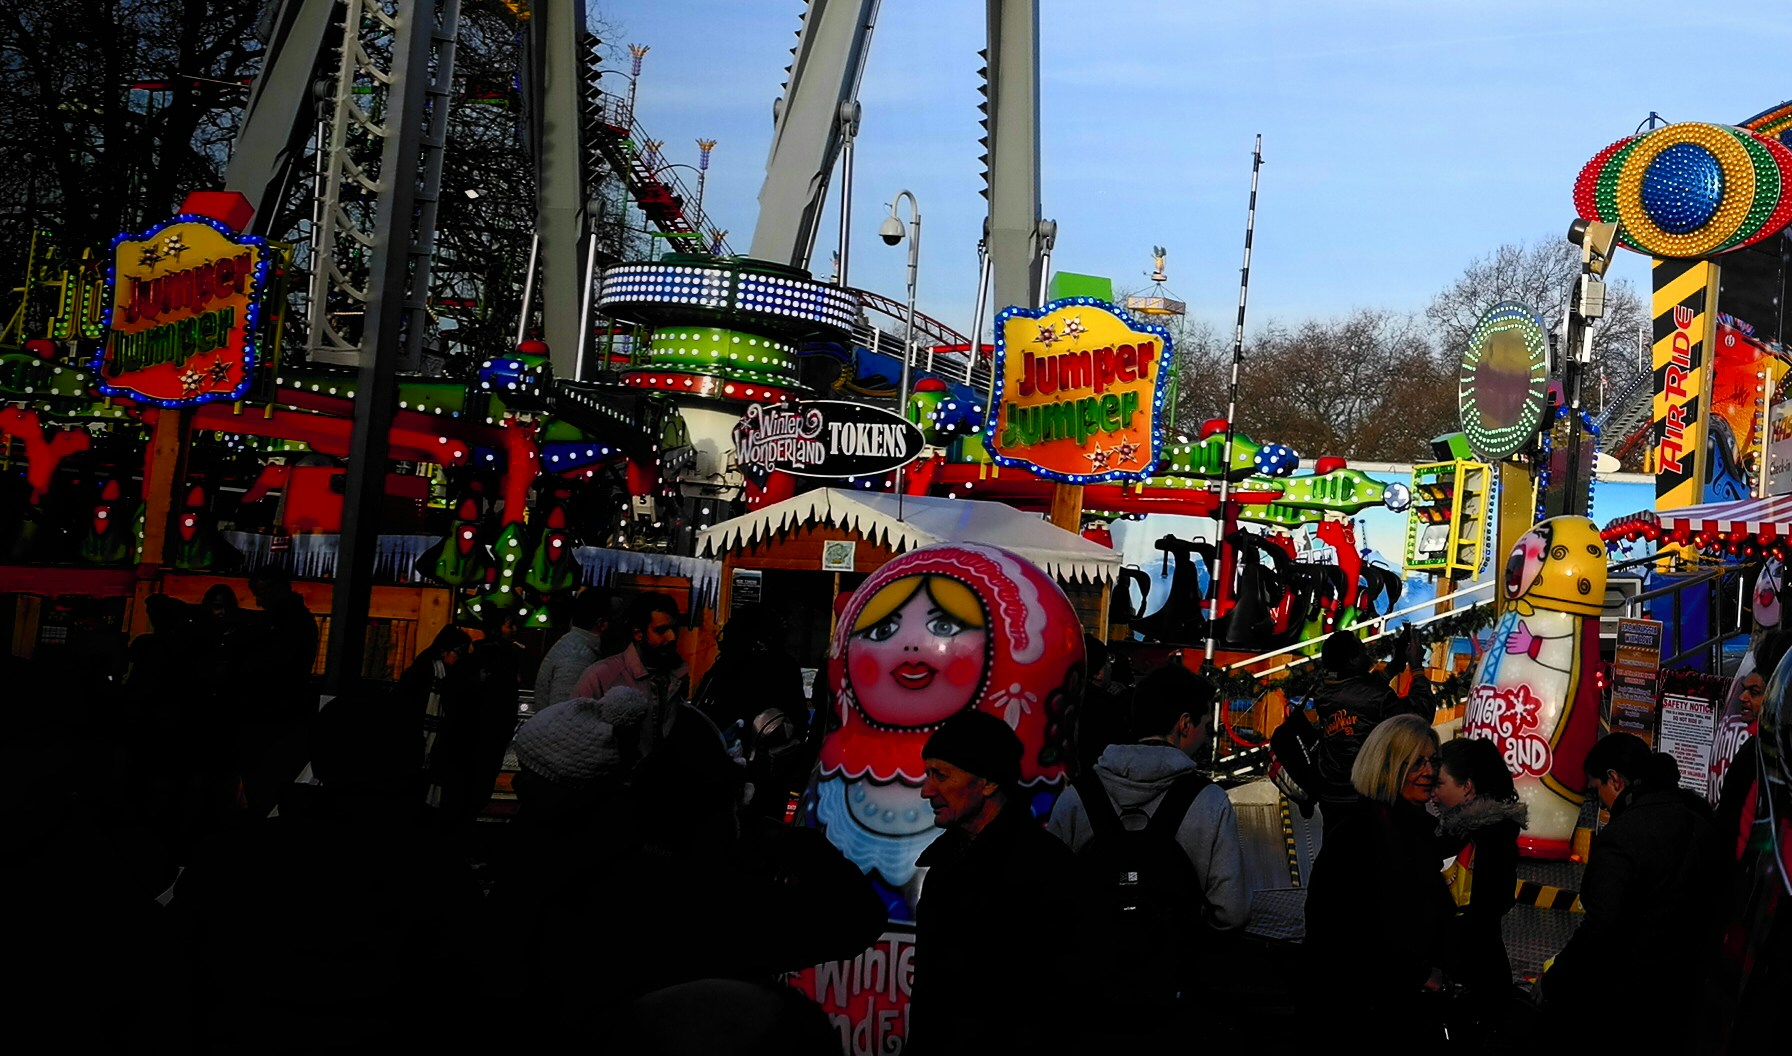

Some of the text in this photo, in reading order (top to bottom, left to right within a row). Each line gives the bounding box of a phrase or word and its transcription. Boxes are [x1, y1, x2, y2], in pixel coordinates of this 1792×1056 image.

[119, 248, 252, 323] Jumper
[1018, 341, 1154, 396] Jumper
[1657, 305, 1693, 474] AIR RIDE
[828, 422, 907, 458] TOKENS
[1001, 391, 1139, 448] Jumper
[1663, 699, 1688, 710] SAFETY
[1690, 703, 1713, 714] NOTICE
